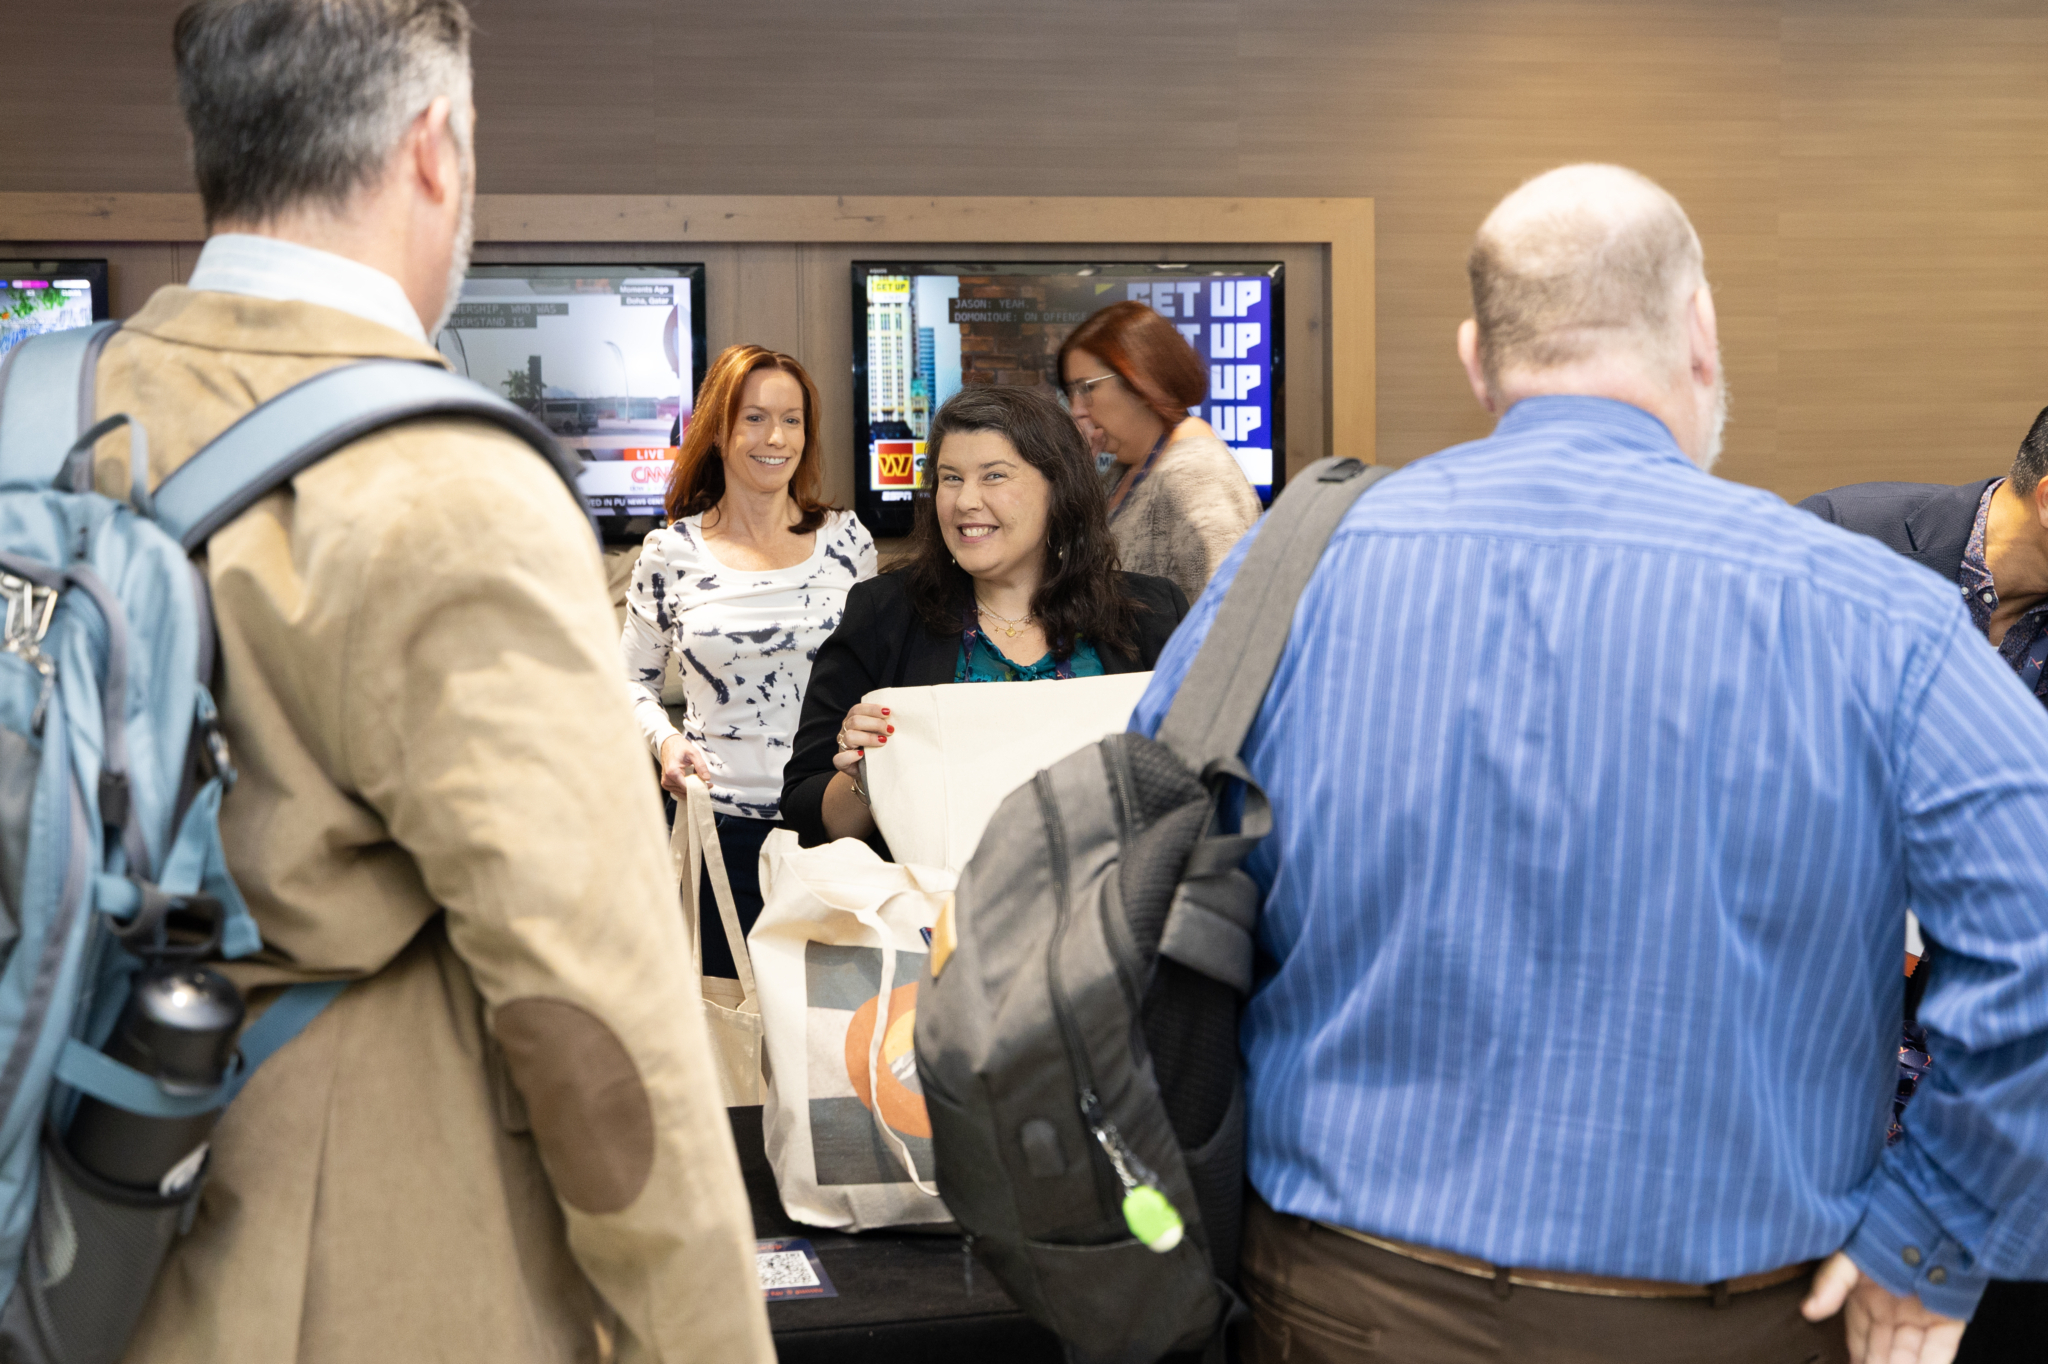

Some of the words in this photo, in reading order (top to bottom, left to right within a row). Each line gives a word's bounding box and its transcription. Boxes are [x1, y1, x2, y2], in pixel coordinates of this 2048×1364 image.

[619, 285, 653, 294] Moments
[654, 285, 669, 295] Ago
[1127, 282, 1201, 317] GET
[1211, 280, 1261, 317] UP
[510, 304, 531, 314] WHO
[536, 304, 557, 314] WAS
[954, 299, 991, 309] JASON:
[449, 317, 506, 327] NDERSTAND
[512, 317, 525, 327] IS
[1024, 312, 1038, 322] ON
[1211, 323, 1261, 359] UP
[1211, 364, 1261, 400] UP
[1211, 406, 1261, 441] UP
[636, 449, 664, 460] LIVE
[631, 466, 669, 483] CNN
[882, 491, 912, 501] ESPN
[603, 498, 612, 507] IN
[627, 498, 646, 506] NEWS
